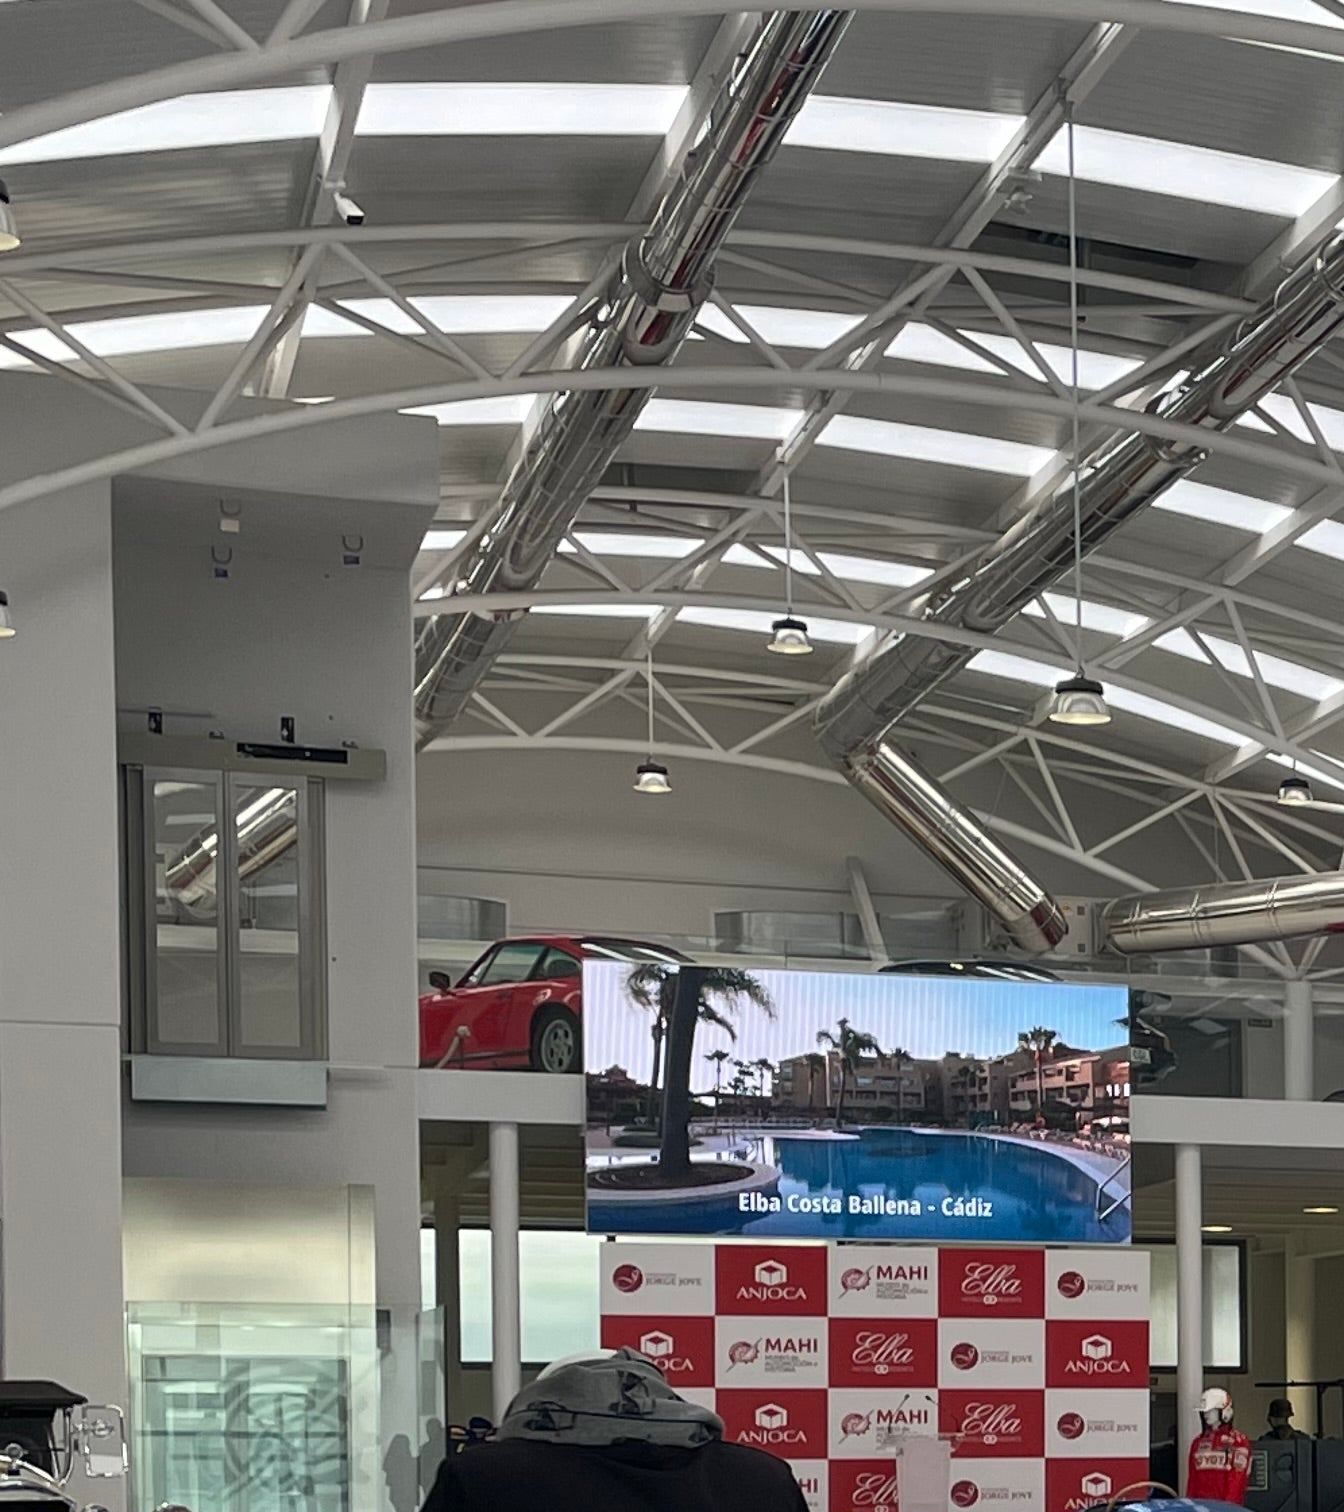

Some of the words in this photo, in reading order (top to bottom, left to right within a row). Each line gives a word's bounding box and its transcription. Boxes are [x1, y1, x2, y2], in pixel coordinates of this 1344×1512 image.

[738, 1192, 781, 1214] Elba
[787, 1194, 842, 1215] Costa
[848, 1195, 921, 1217] Ballena
[941, 1195, 993, 1218] Cádiz
[876, 1265, 928, 1280] MAHI
[961, 1262, 1022, 1295] Elba
[736, 1286, 807, 1301] ANJOCA
[764, 1337, 818, 1353] MAHI
[852, 1331, 914, 1364] Elba
[653, 1357, 694, 1371] OCA
[1064, 1360, 1131, 1375] ANJOCA
[876, 1409, 928, 1424] MAHI
[961, 1402, 1022, 1435] Elba
[737, 1429, 807, 1444] ANJOCA
[800, 1478, 818, 1493] HI
[852, 1472, 898, 1506] Elb
